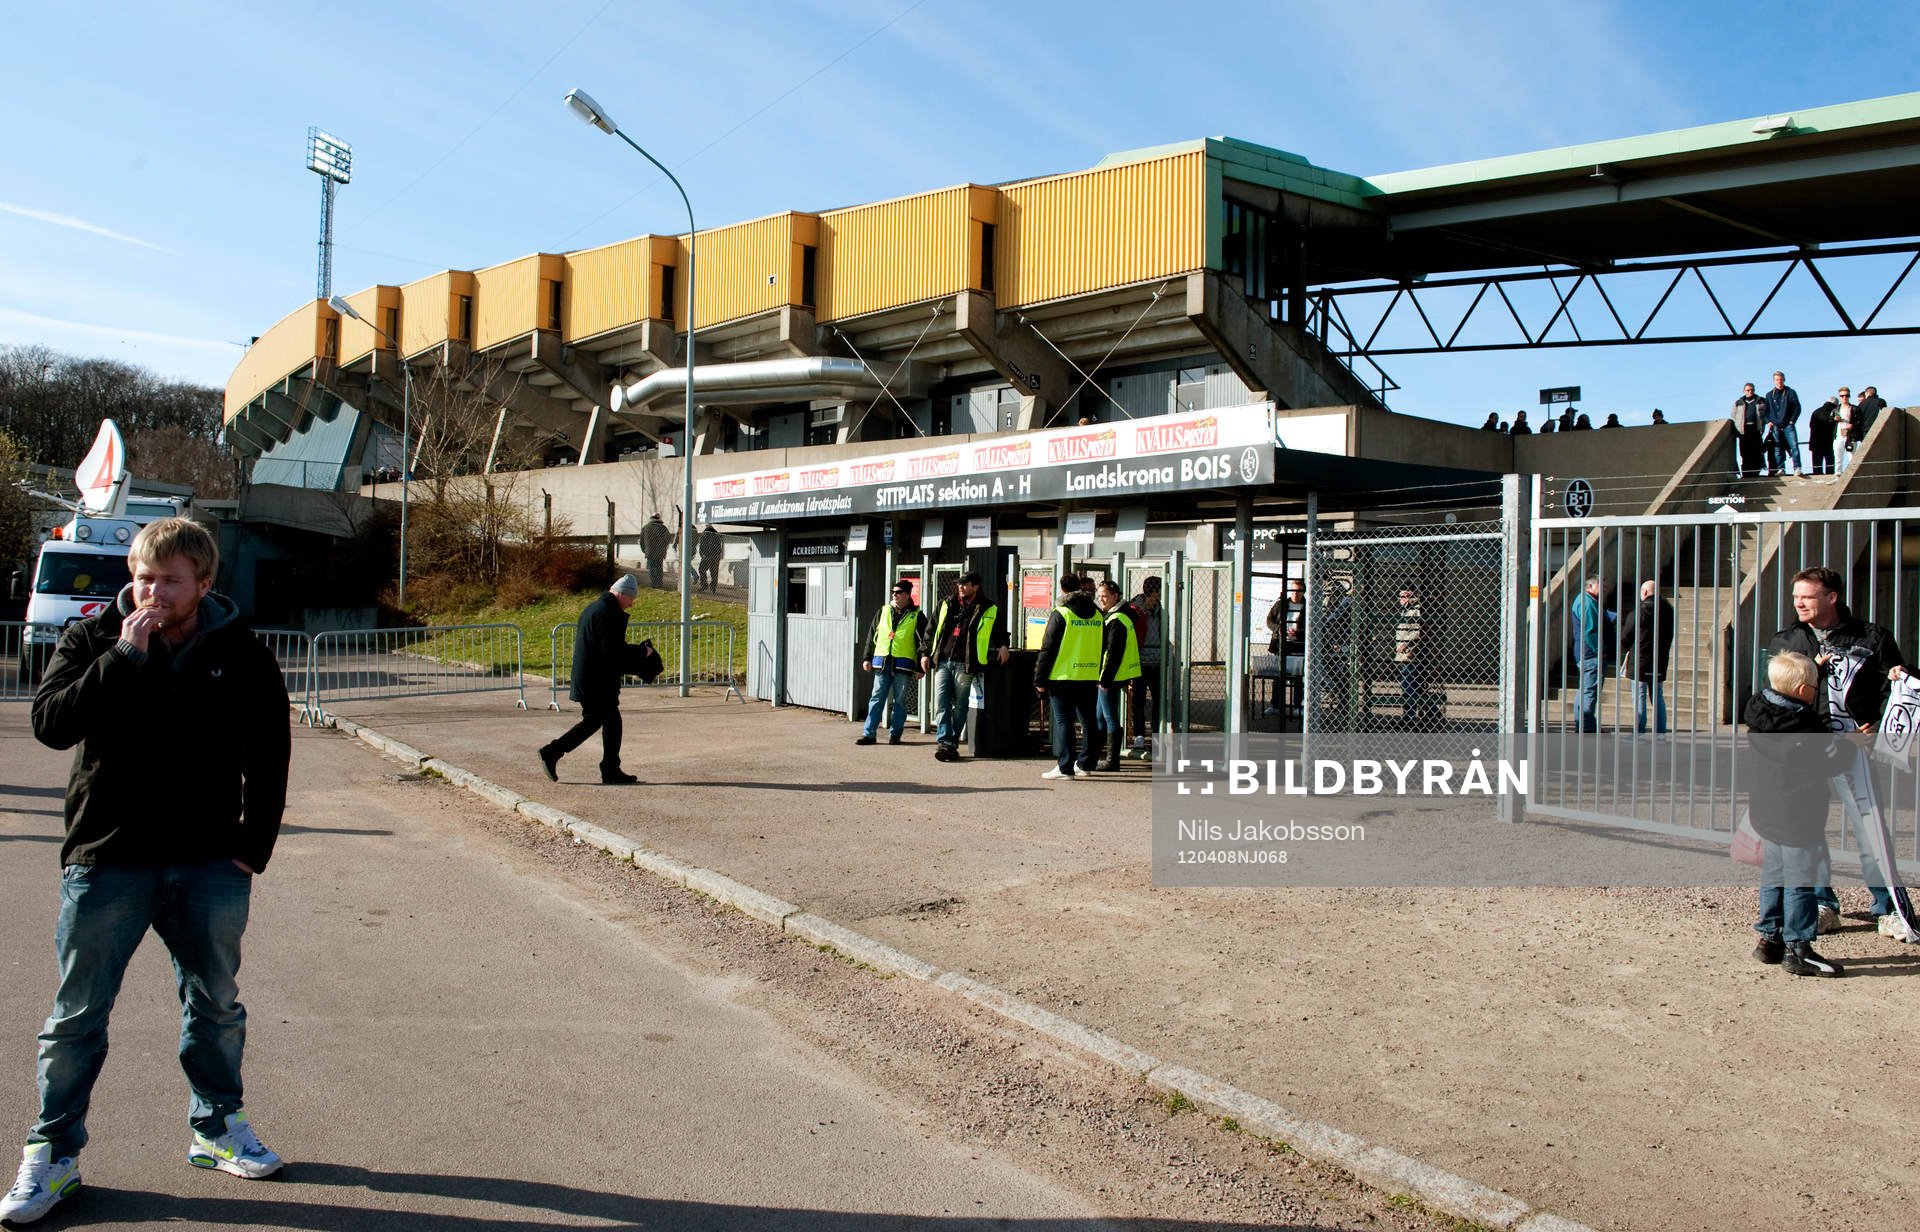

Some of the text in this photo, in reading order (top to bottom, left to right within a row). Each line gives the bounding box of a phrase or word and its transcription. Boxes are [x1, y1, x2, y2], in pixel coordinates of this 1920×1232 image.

[92, 433, 114, 493] 4
[1066, 454, 1232, 492] Landskrona BOIS
[876, 483, 934, 506] SITTPLATS
[938, 479, 988, 502] sektion
[991, 477, 1004, 497] A
[1019, 474, 1031, 495] H
[1708, 496, 1745, 505] SEKTION
[711, 494, 852, 518] Välkommen till Landskrona Idrottsplats
[1254, 525, 1307, 540] PPGÅ
[792, 545, 839, 555] ACKREDITERING
